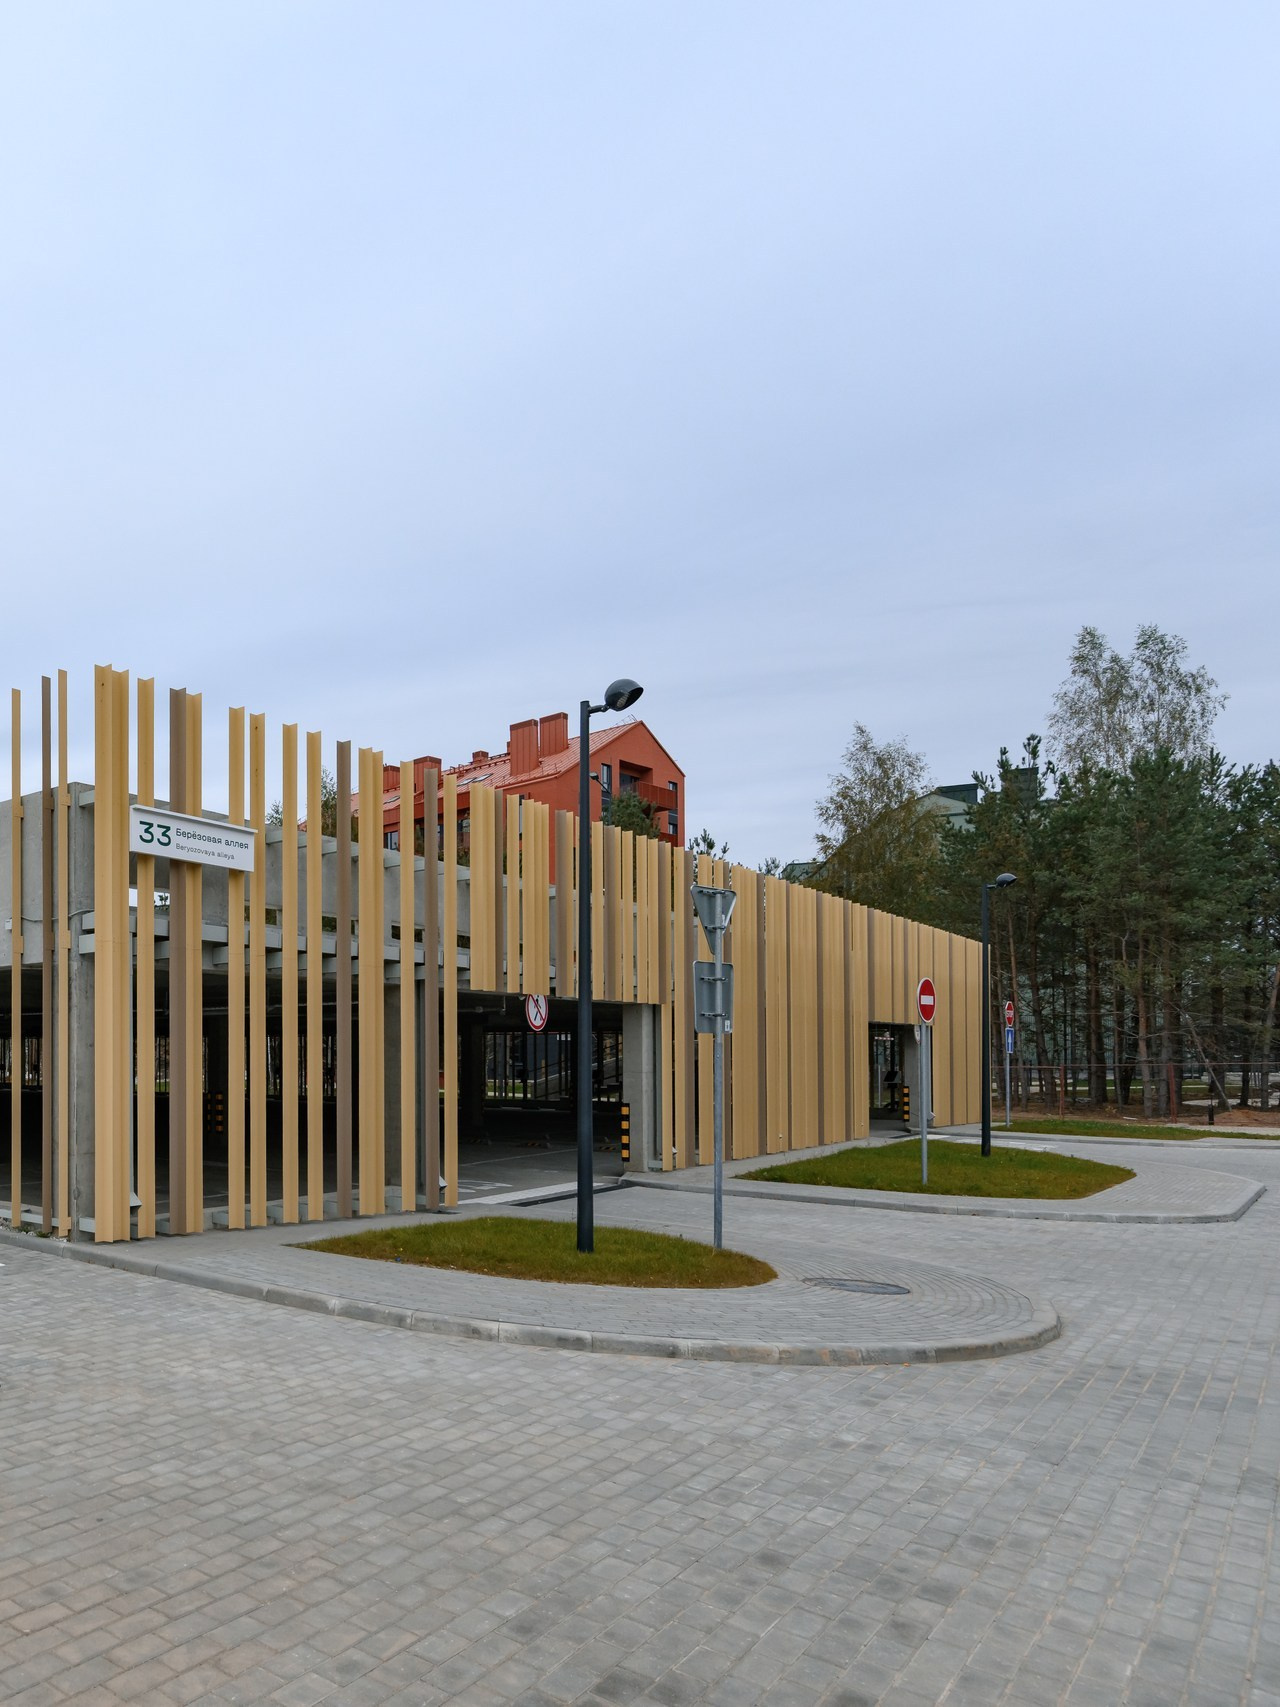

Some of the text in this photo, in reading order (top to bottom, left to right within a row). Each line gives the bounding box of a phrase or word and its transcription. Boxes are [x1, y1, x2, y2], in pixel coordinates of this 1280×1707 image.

[139, 820, 172, 846] 33
[176, 828, 249, 850] Берёзовая аллея
[176, 843, 216, 857] Beryozovaya
